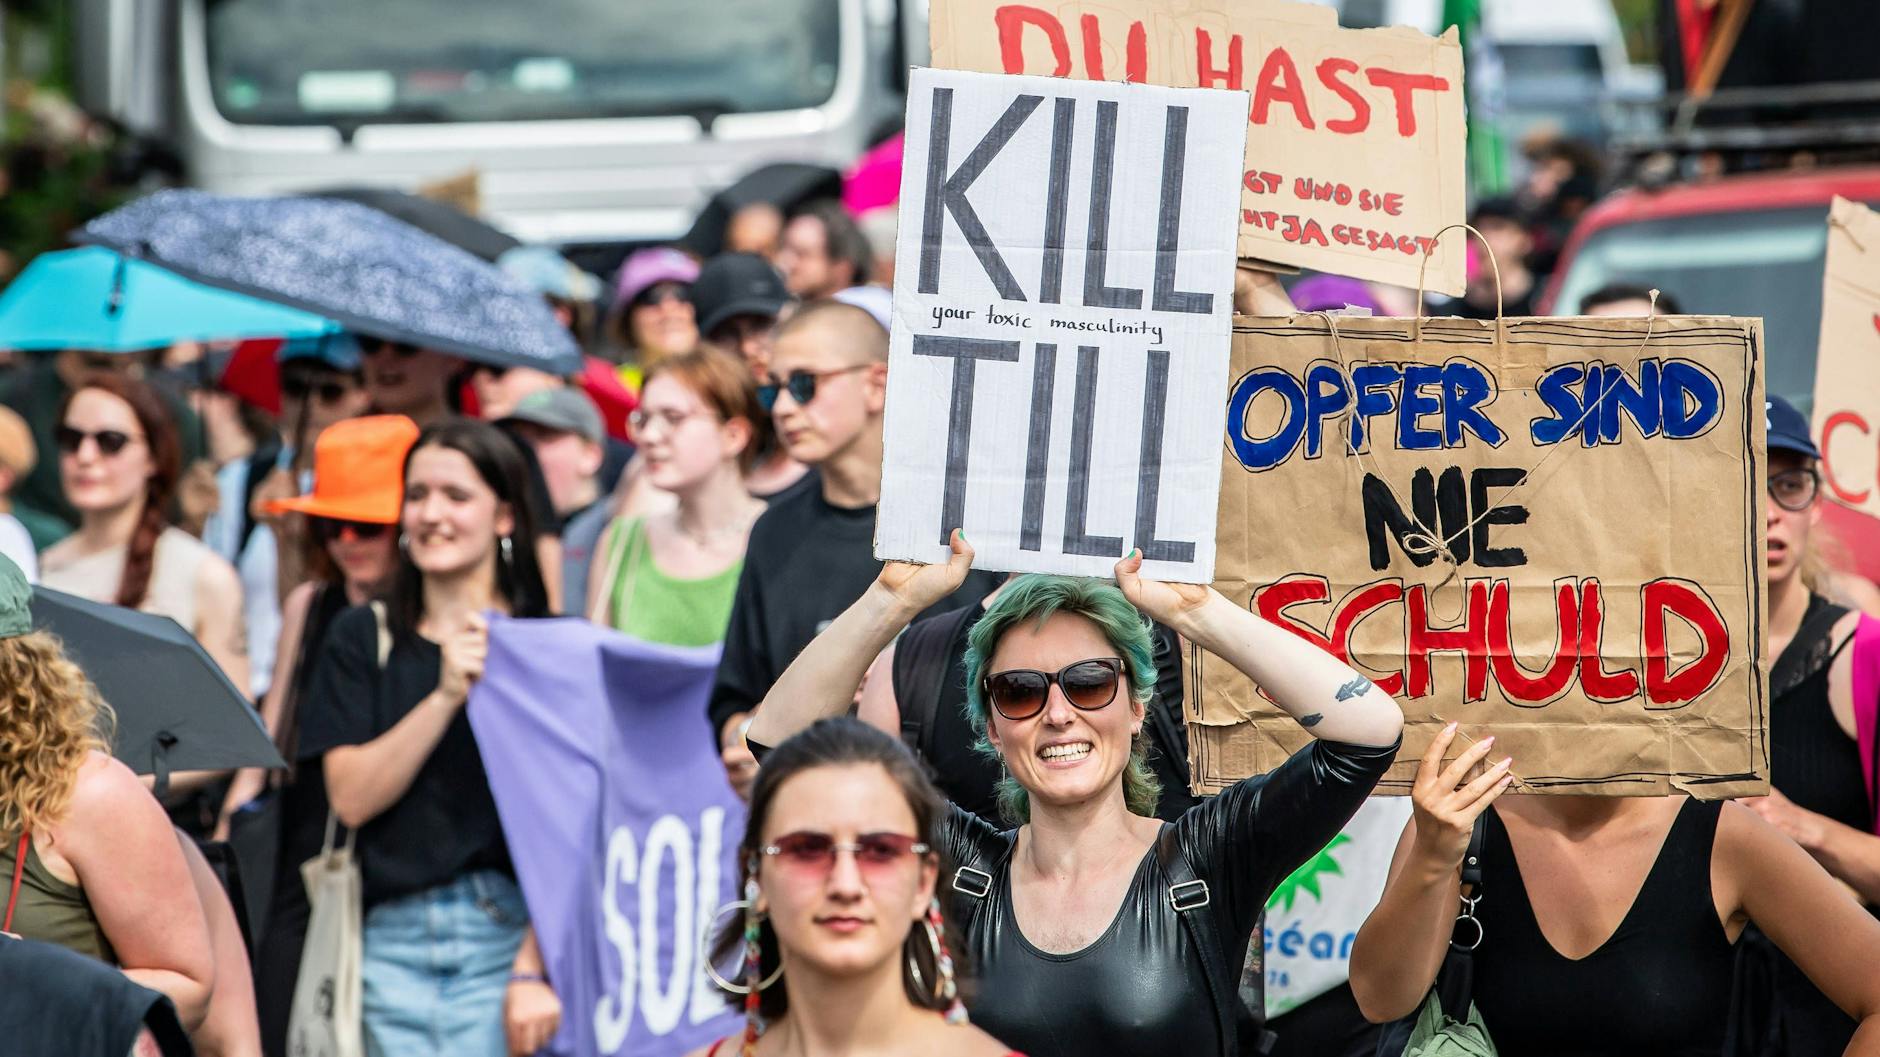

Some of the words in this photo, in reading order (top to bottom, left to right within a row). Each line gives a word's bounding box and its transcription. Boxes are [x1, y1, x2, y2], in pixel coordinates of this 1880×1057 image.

[994, 5, 1147, 85] DU
[1196, 26, 1450, 138] HAST
[917, 87, 1214, 315] KILL
[1281, 215, 1330, 247] JA
[1331, 223, 1439, 257] GESAGT
[1294, 177, 1353, 206] UND
[1358, 188, 1404, 217] SIE
[932, 304, 976, 329] your
[985, 304, 1033, 329] toxic
[1049, 318, 1163, 345] masculinity
[912, 333, 1197, 563] TILL
[1226, 357, 1509, 473] OPFER
[1530, 358, 1726, 449] SIND
[1361, 465, 1531, 572] NIE
[1250, 572, 1730, 711] SCHULD
